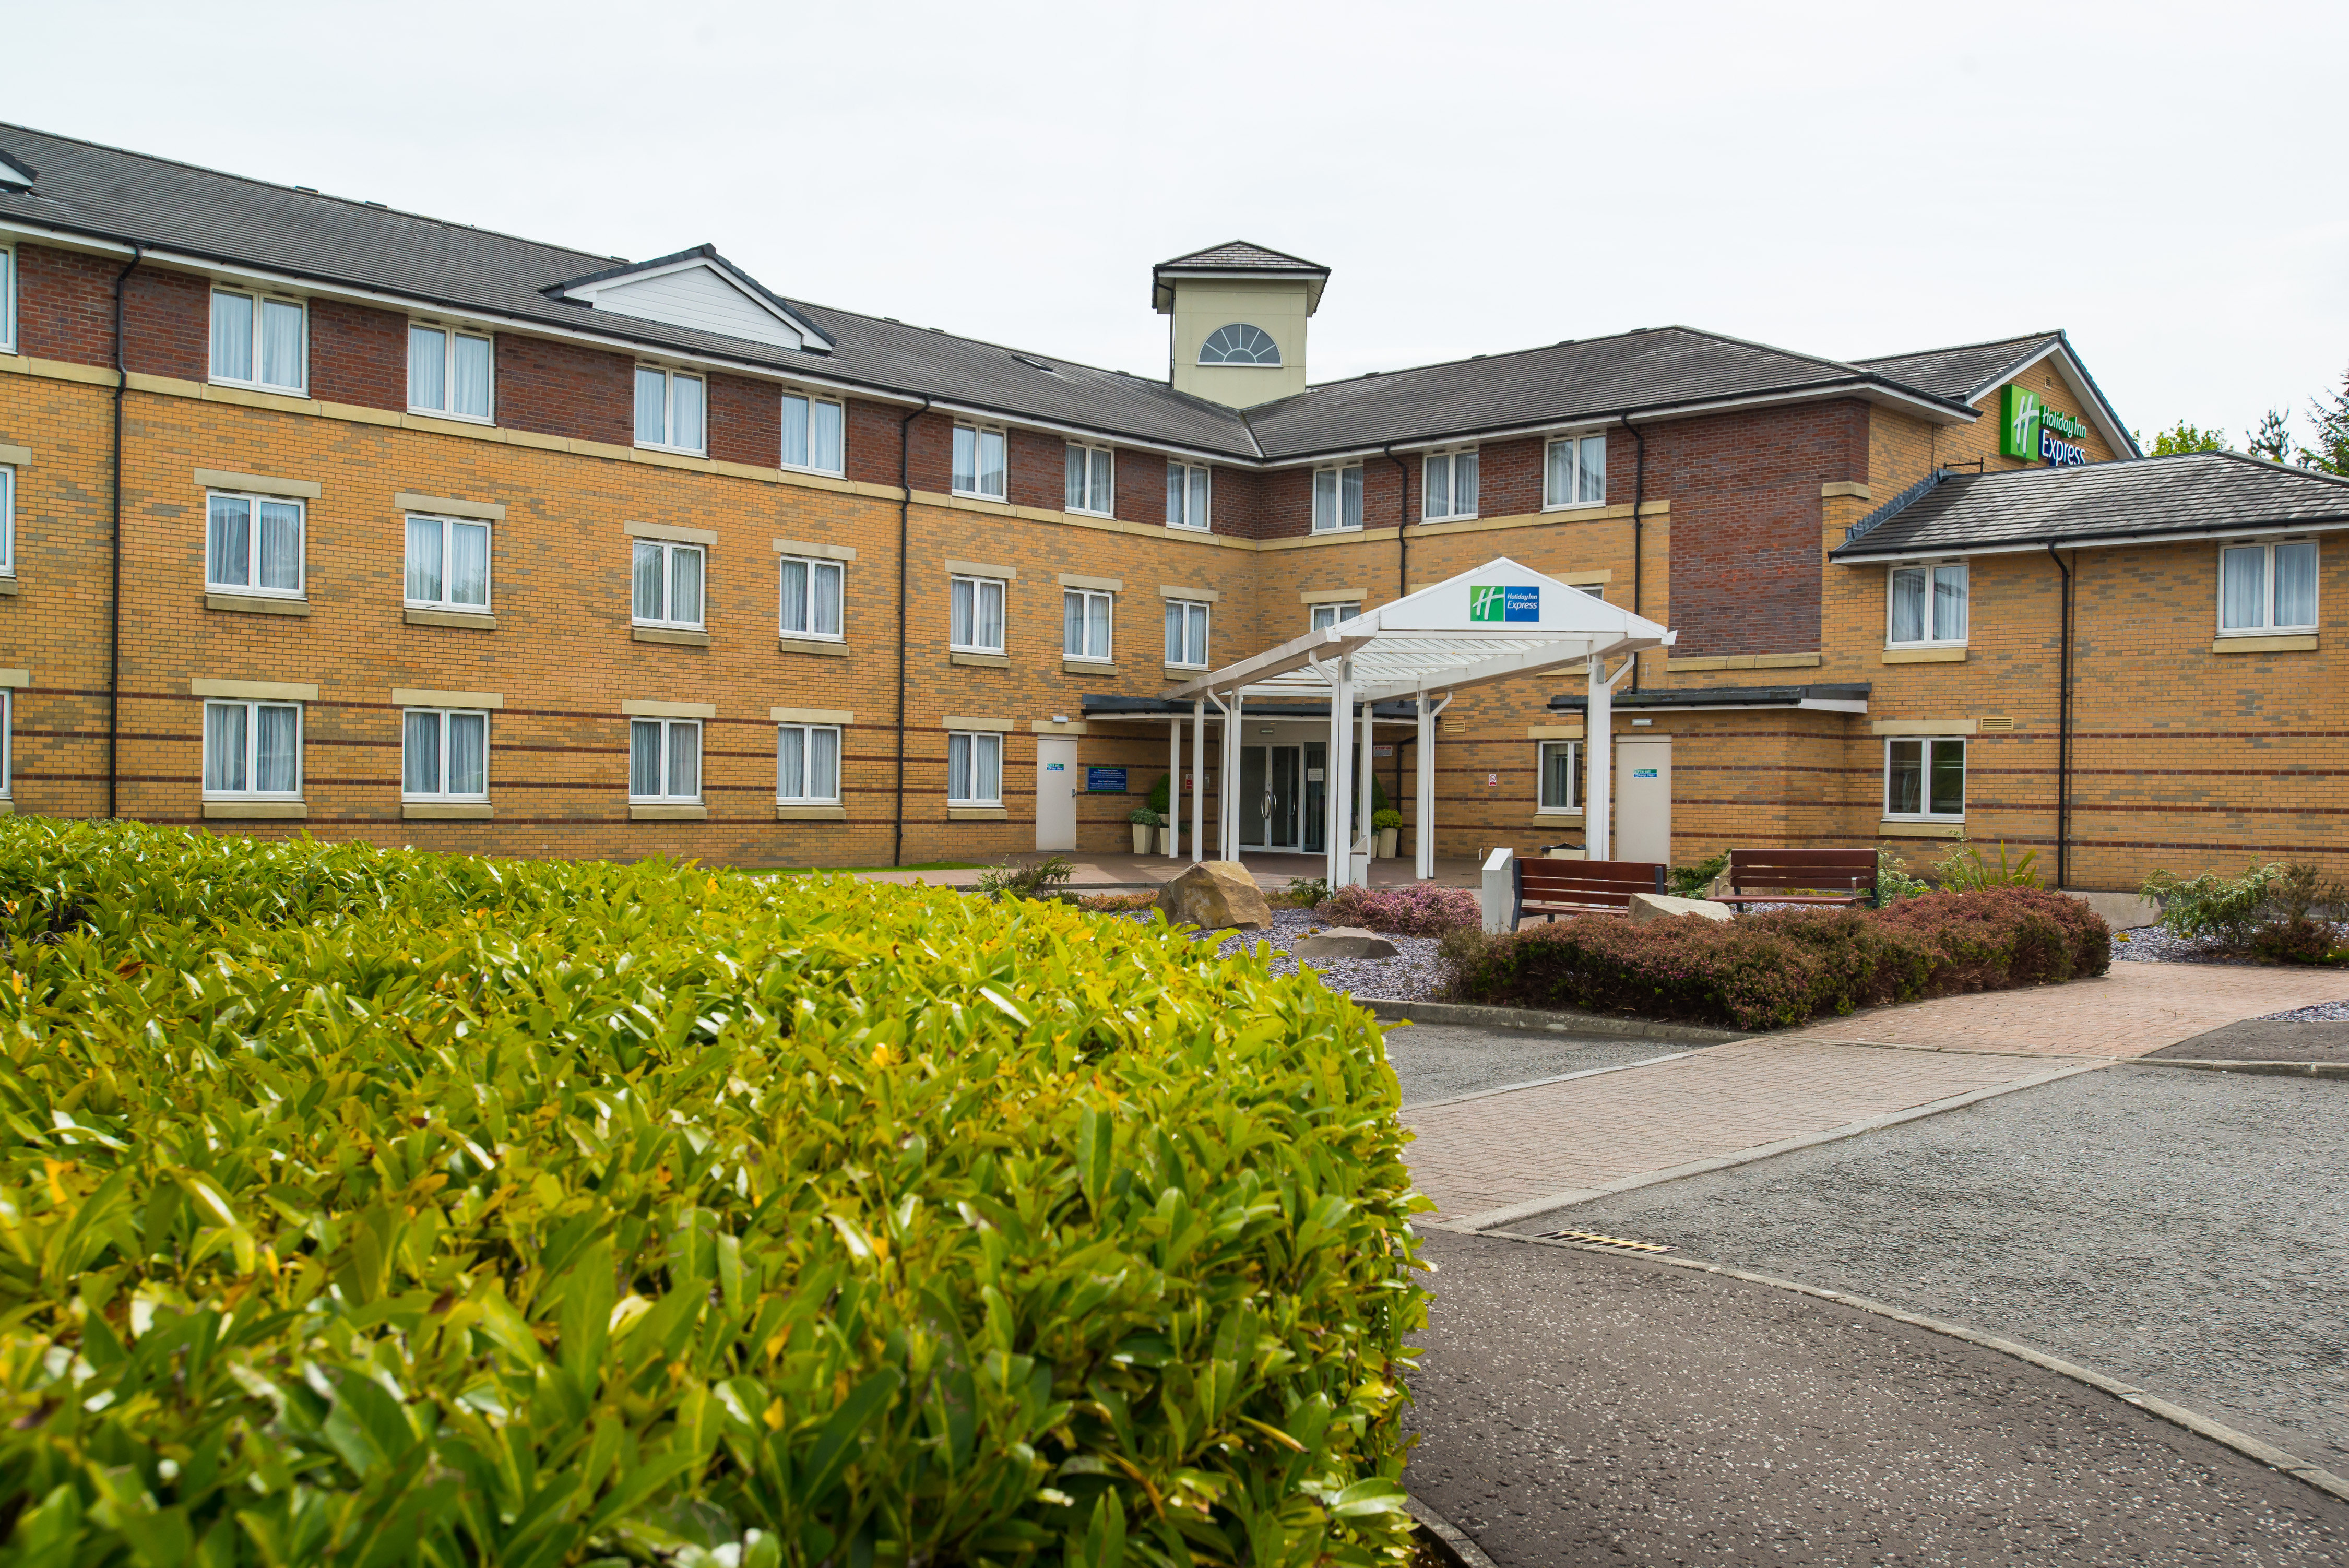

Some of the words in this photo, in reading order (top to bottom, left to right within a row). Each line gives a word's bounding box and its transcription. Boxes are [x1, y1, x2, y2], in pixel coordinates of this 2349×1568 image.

[2042, 405, 2073, 438] Holiday
[2074, 416, 2086, 438] Inn
[2042, 429, 2085, 466] Express
[1507, 600, 1538, 611] Express
